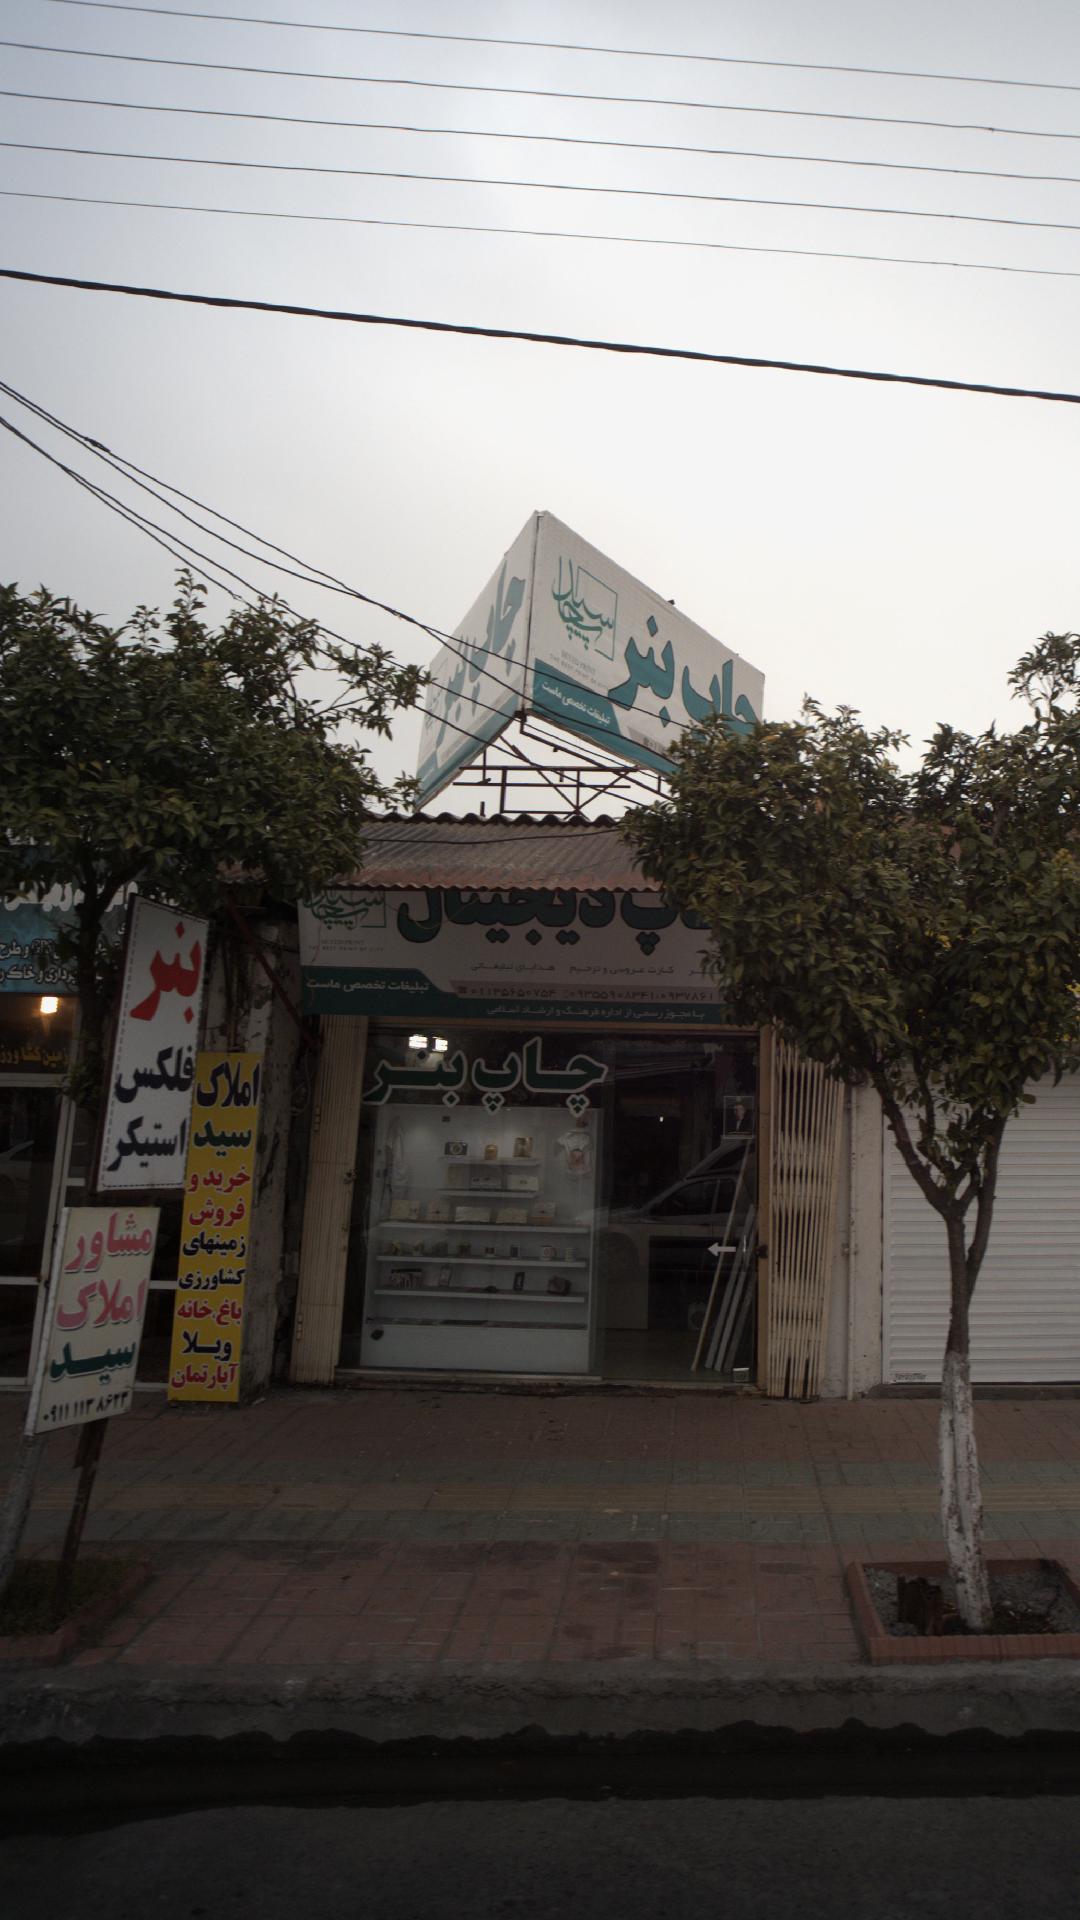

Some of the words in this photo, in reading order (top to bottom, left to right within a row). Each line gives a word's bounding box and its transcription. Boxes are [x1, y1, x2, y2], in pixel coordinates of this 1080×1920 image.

[608, 615, 675, 728] بنر
[128, 921, 201, 1024] بنر
[114, 1043, 195, 1103] فلکس
[196, 1061, 260, 1108] املاک
[362, 1050, 468, 1107] بنر
[471, 1035, 609, 1117] چاپ
[106, 1115, 187, 1172] استیکر
[194, 1120, 252, 1156] سید
[187, 1172, 199, 1192] و
[202, 1166, 250, 1193] خرید
[189, 1197, 245, 1227] فروش
[64, 1210, 153, 1272] مشاور
[182, 1231, 246, 1258] زمینهای
[178, 1268, 246, 1291] کشاورزی
[56, 1278, 147, 1330] املاک
[177, 1300, 212, 1319] خانه
[50, 1341, 136, 1383] سید
[182, 1331, 233, 1361] ویلا
[171, 1362, 238, 1390] آپارتمان
[43, 1402, 69, 1422] ۰۹۱۱
